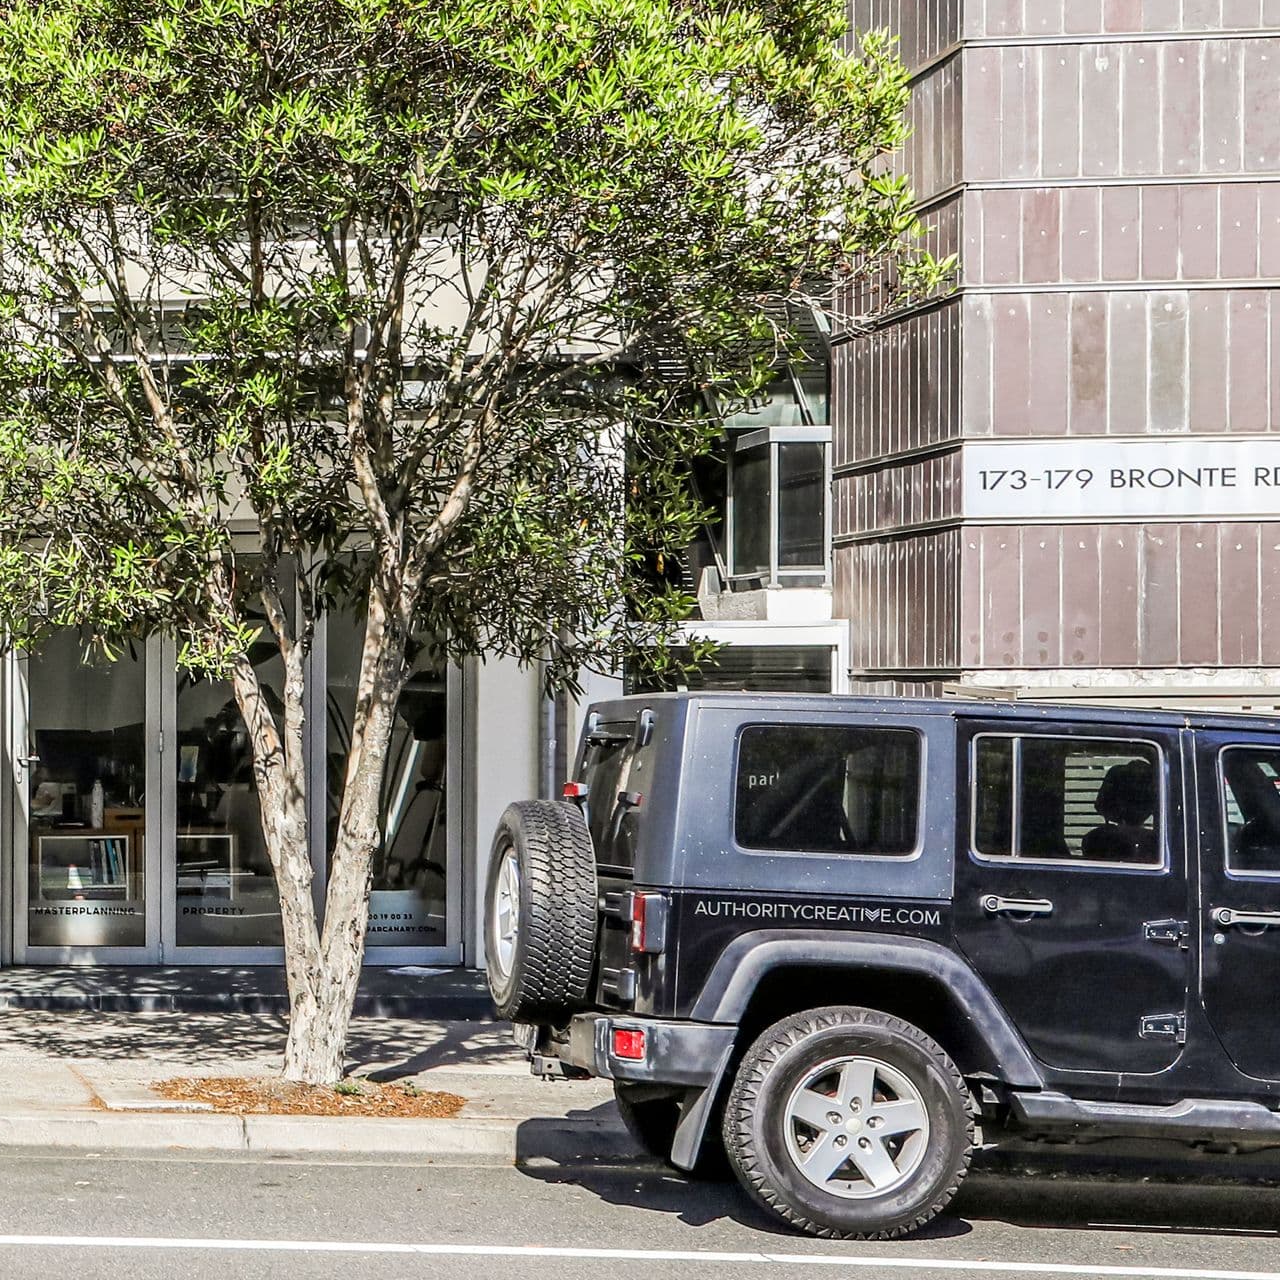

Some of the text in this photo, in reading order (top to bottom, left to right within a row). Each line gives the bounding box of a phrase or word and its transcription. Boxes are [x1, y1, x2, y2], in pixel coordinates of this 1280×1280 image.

[978, 469, 1094, 490] 173-179
[1109, 467, 1237, 488] BRONTE
[34, 906, 136, 916] MASTERPLANNING
[182, 906, 246, 916] PROPERTY
